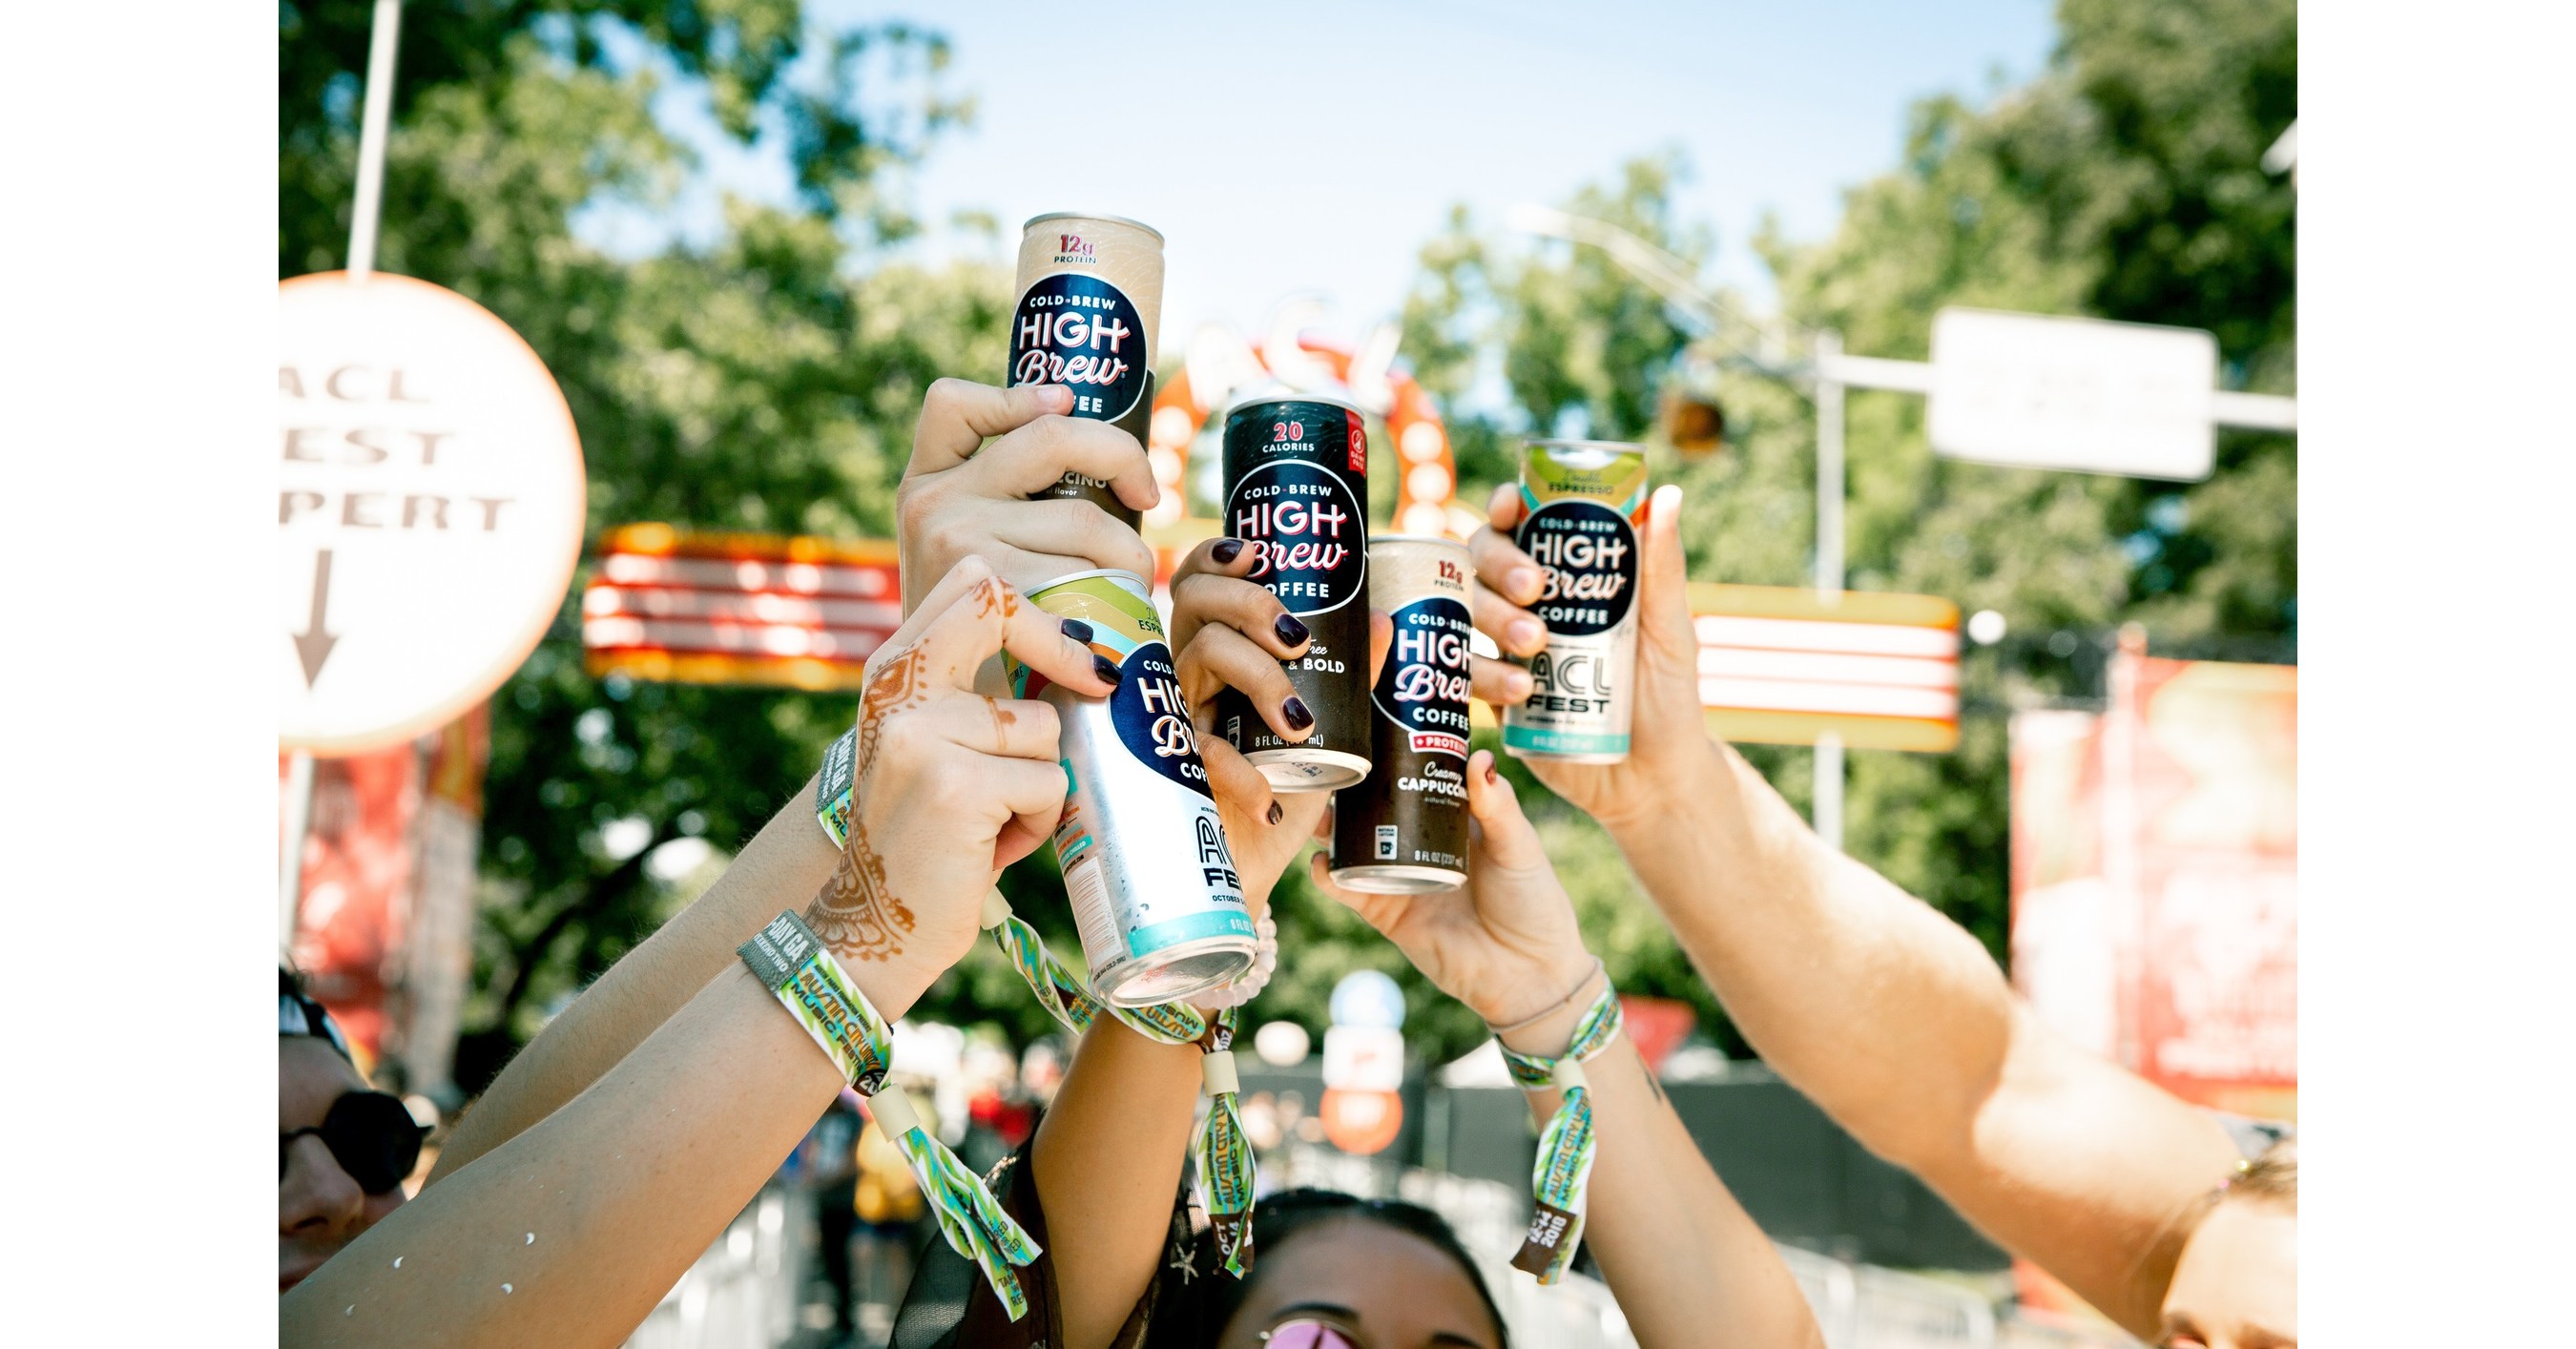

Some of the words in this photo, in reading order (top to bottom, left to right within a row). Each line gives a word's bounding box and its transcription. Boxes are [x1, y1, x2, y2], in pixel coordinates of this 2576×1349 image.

[1061, 234, 1094, 256] 12g
[1053, 256, 1097, 264] PROTEIN
[1029, 295, 1116, 311] COLD-BREW
[1019, 311, 1131, 354] HIGH
[1015, 348, 1130, 386] Brew
[1273, 421, 1304, 443] 20
[280, 427, 457, 467] EST
[1262, 443, 1315, 453] CALORIES
[1244, 484, 1333, 500] COLD-BREW
[279, 490, 516, 531] PERT
[1236, 500, 1347, 539] HIGH
[1539, 516, 1618, 533] COLD-BREW
[1529, 532, 1628, 571] HIGH
[1439, 560, 1463, 584] 12g
[1265, 582, 1329, 598] OFFEE
[1539, 606, 1609, 625] COFFEE
[1310, 638, 1328, 655] ree
[1288, 660, 1298, 671] &
[1303, 657, 1345, 674] BOLD
[1530, 651, 1612, 695] ACL
[1136, 676, 1190, 720] HIG
[1527, 694, 1610, 714] FEST
[1255, 737, 1260, 747] 8
[1262, 736, 1271, 746] FL
[1308, 734, 1324, 747] mL)
[1398, 777, 1467, 800] CAPPUCCIN
[764, 915, 799, 944] -DAY
[752, 931, 776, 957] EEKEND
[770, 953, 789, 973] TWO
[781, 933, 810, 962] GA
[790, 981, 837, 1035] MUSIC
[799, 969, 848, 1026] AUSTIN
[841, 1021, 867, 1048] CITY
[859, 1073, 877, 1092] 20
[1229, 1149, 1244, 1201] MUSIC
[1215, 1221, 1231, 1255] OCT
[1539, 1214, 1567, 1248] 2018
